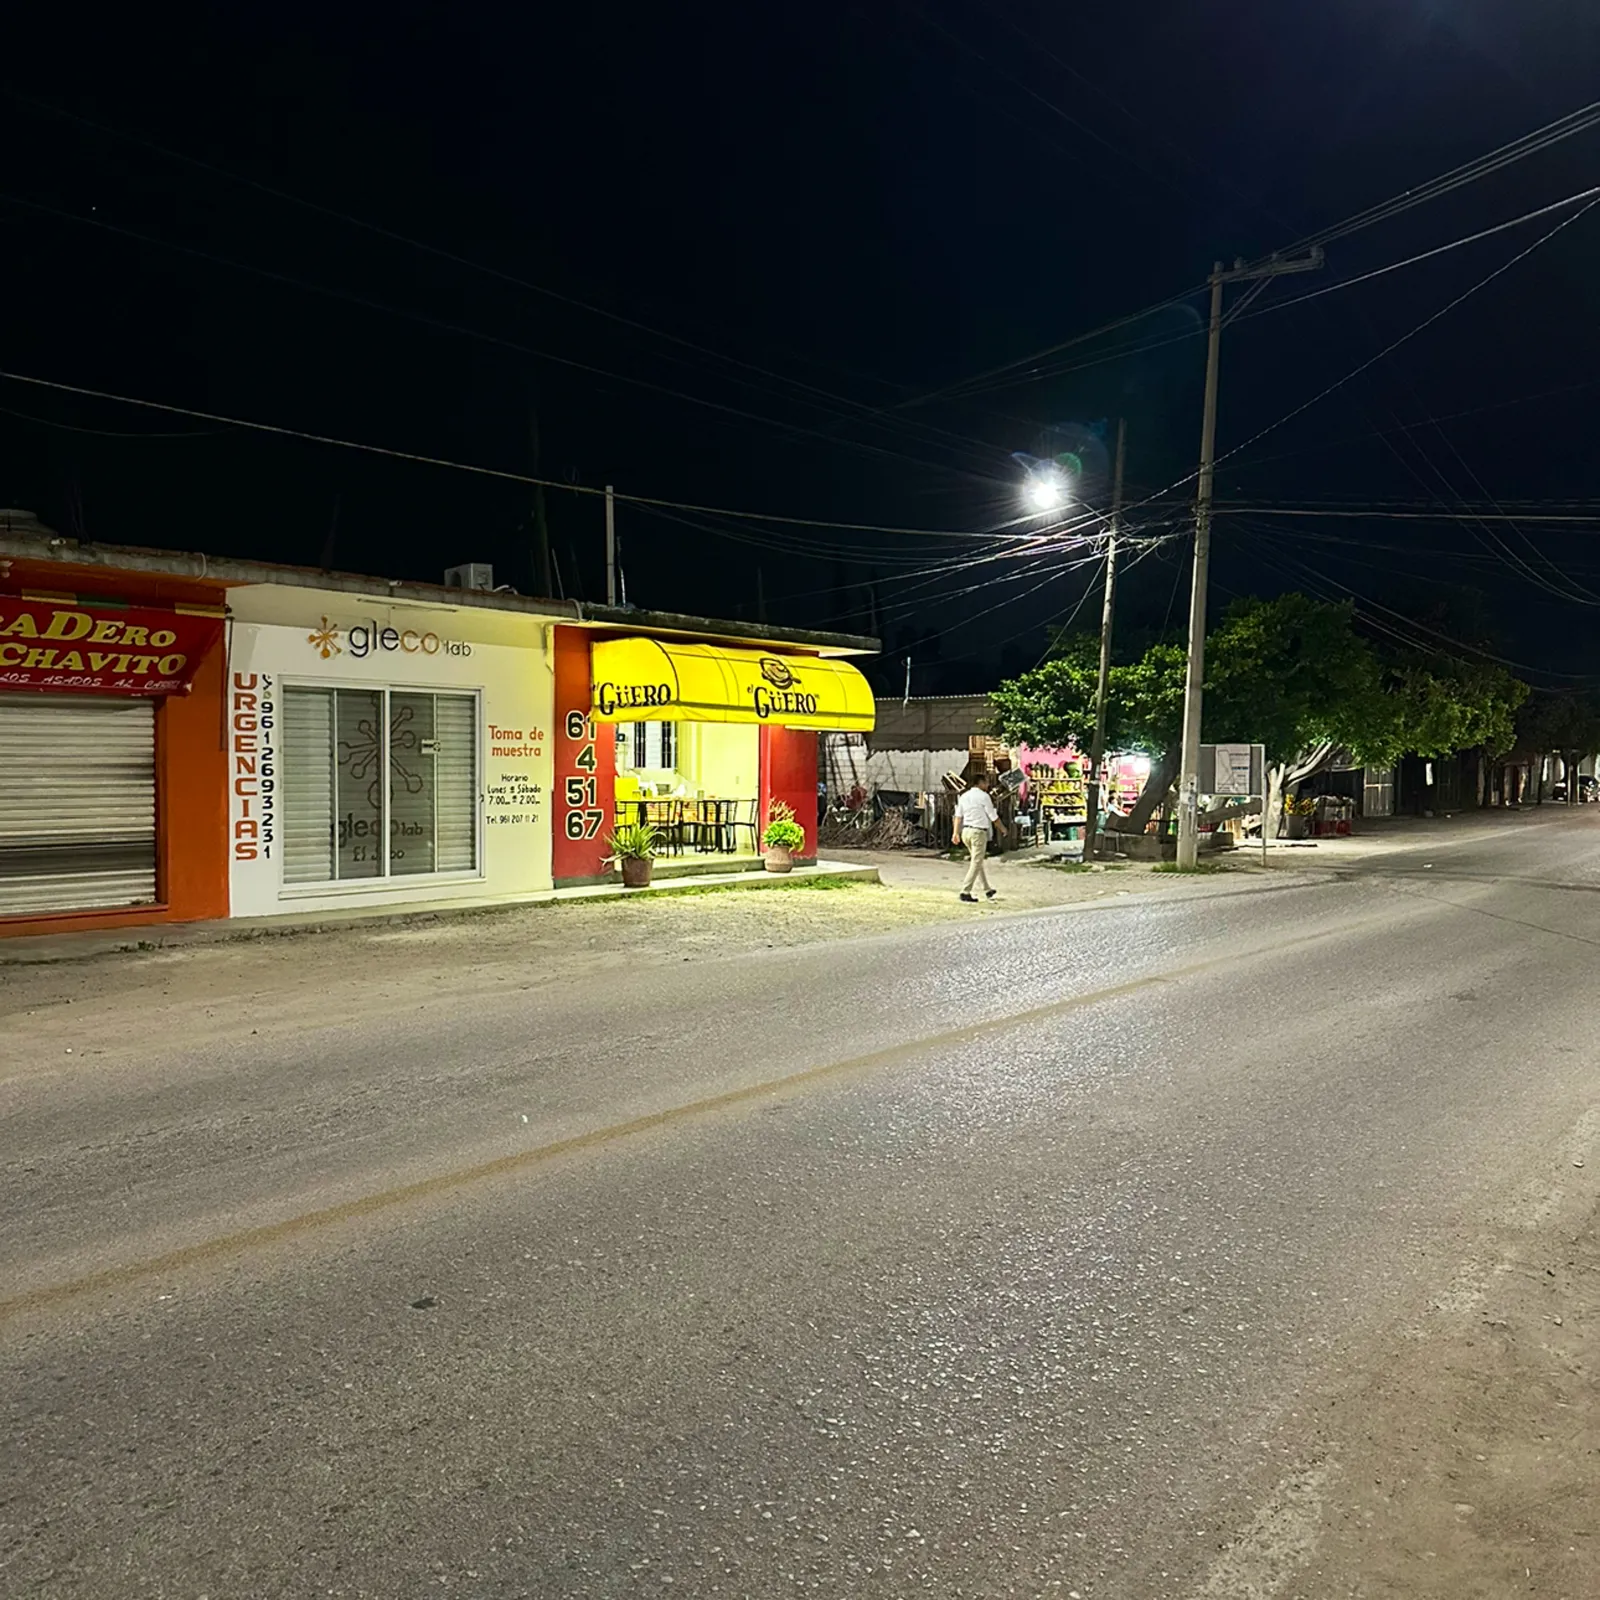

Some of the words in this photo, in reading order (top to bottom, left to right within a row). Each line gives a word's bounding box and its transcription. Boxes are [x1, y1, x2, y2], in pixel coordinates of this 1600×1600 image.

[0, 611, 176, 647] ADERO
[349, 619, 440, 658] gleco
[446, 640, 471, 656] lab
[0, 642, 187, 675] CHAVITO
[43, 675, 103, 687] ASADOS
[113, 679, 133, 688] AL
[599, 682, 671, 715] GÜERO
[754, 686, 816, 718] GÜERO
[488, 725, 522, 740] Toma
[529, 726, 544, 740] de
[492, 743, 541, 757] muestra
[575, 743, 597, 774] 4
[234, 672, 258, 860] URGENCIAS
[261, 701, 274, 859] 9612693231
[501, 774, 529, 782] Horario
[487, 784, 506, 794] Lunes
[565, 776, 597, 807] 51
[401, 822, 423, 836] lab
[565, 809, 604, 840] 67
